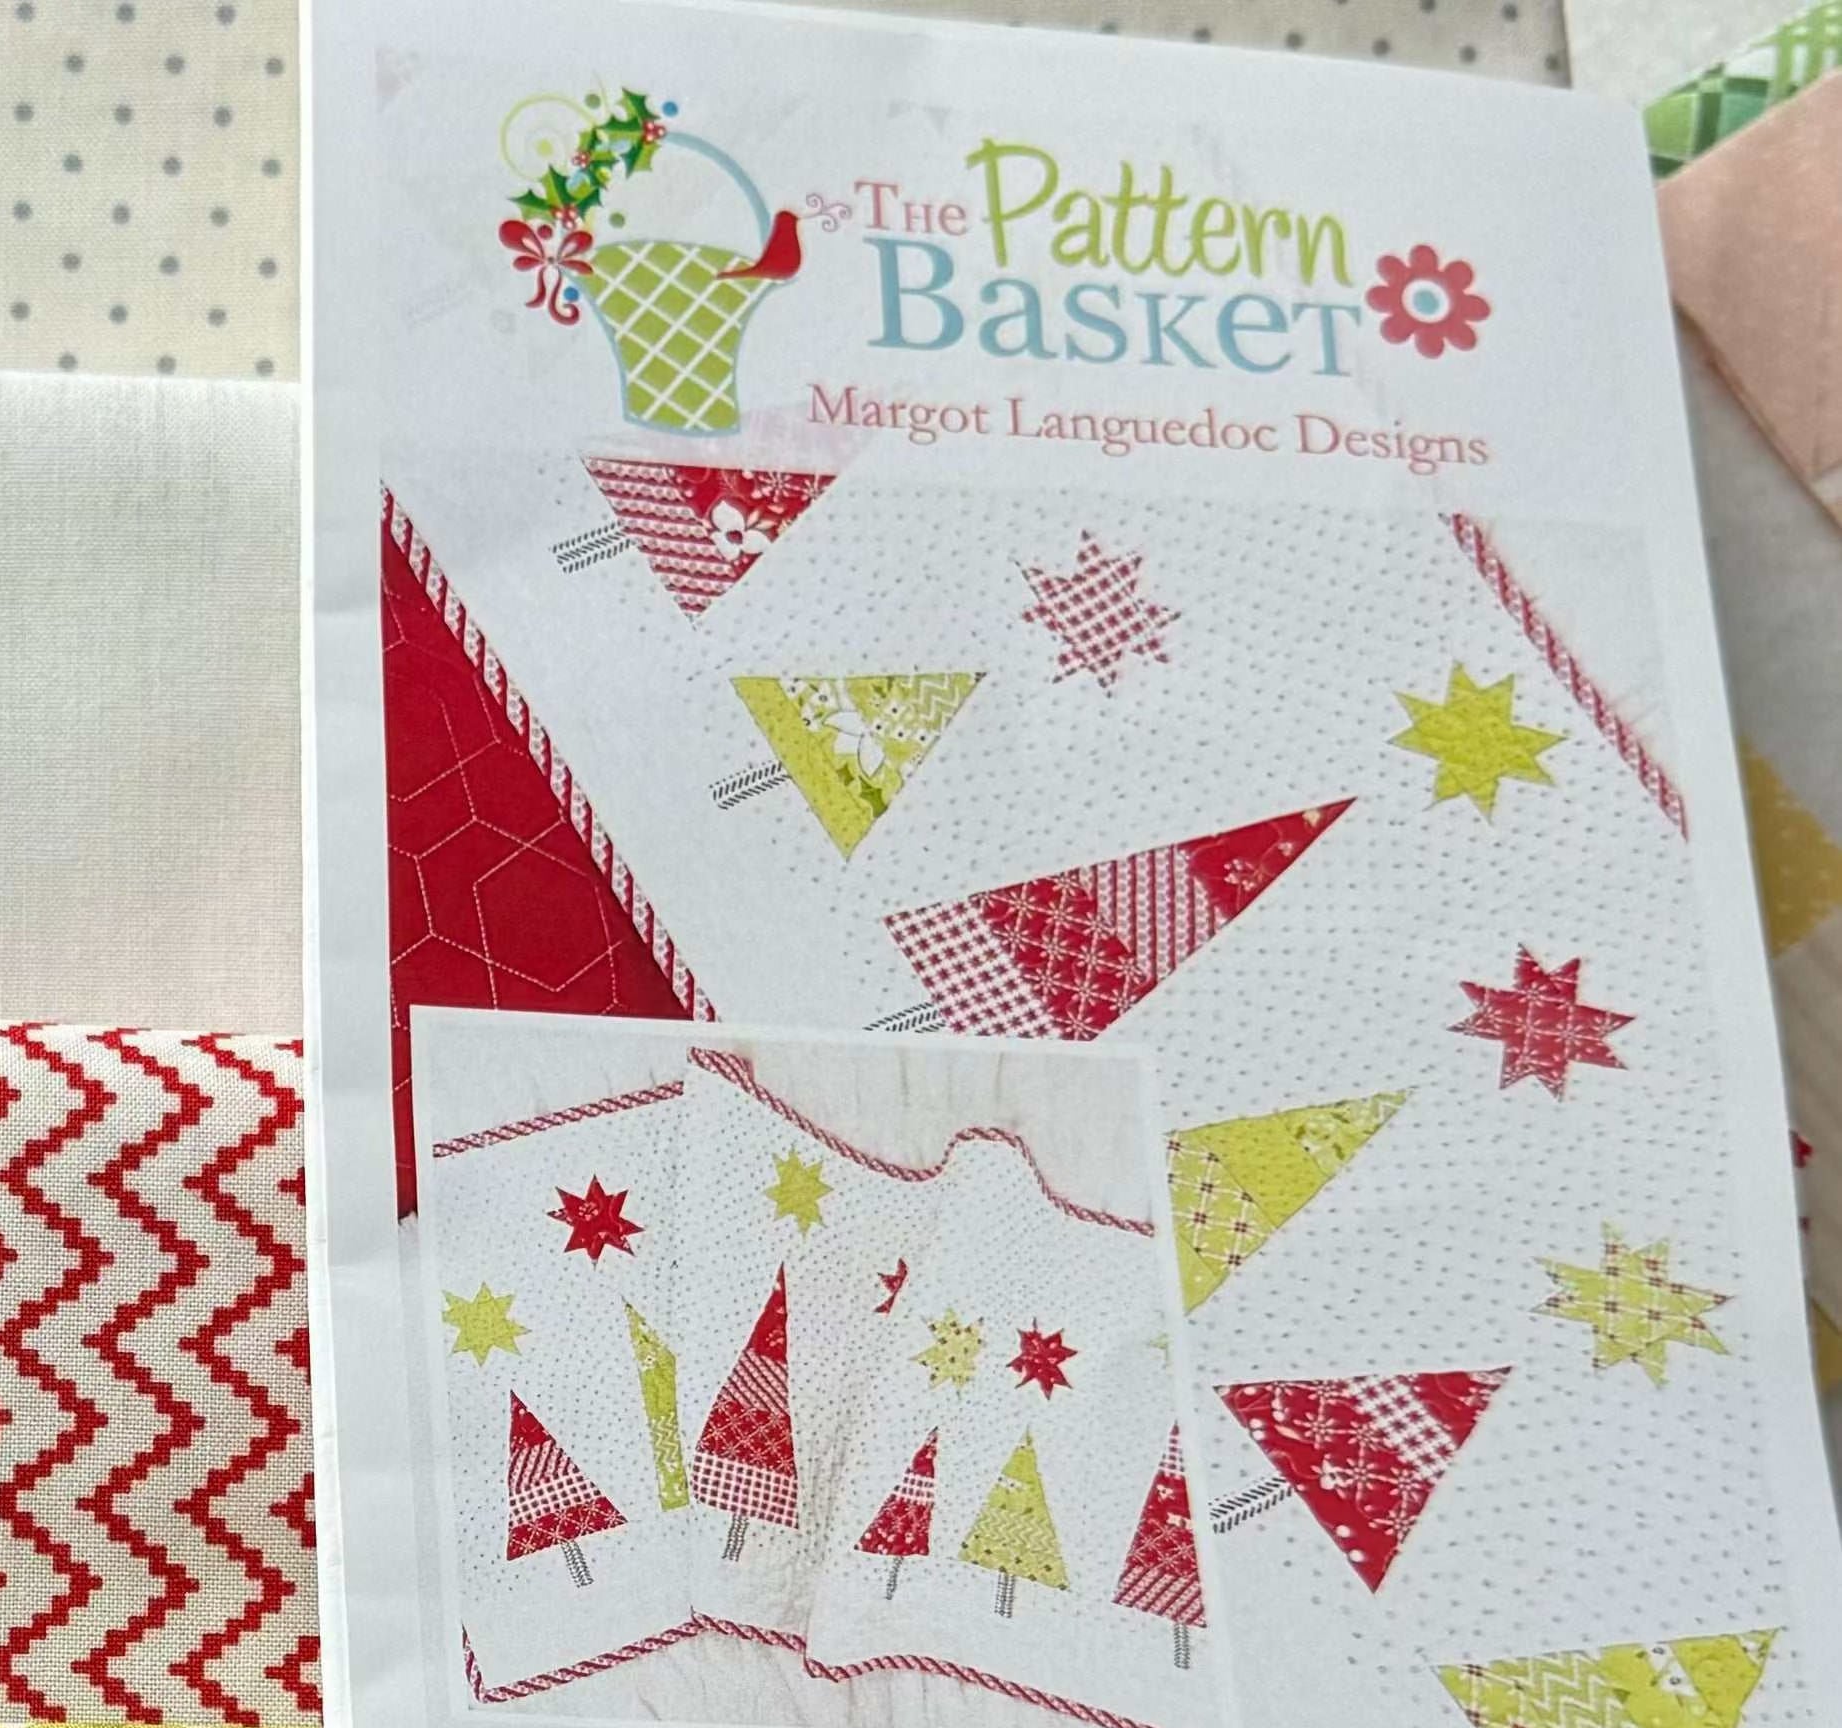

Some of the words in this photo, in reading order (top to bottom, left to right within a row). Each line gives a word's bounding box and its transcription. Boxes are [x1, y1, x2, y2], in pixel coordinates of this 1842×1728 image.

[966, 138, 1354, 288] Pattern
[806, 383, 989, 445] Margot
[1006, 396, 1279, 457] Languedoc
[1295, 412, 1490, 473] Designs
